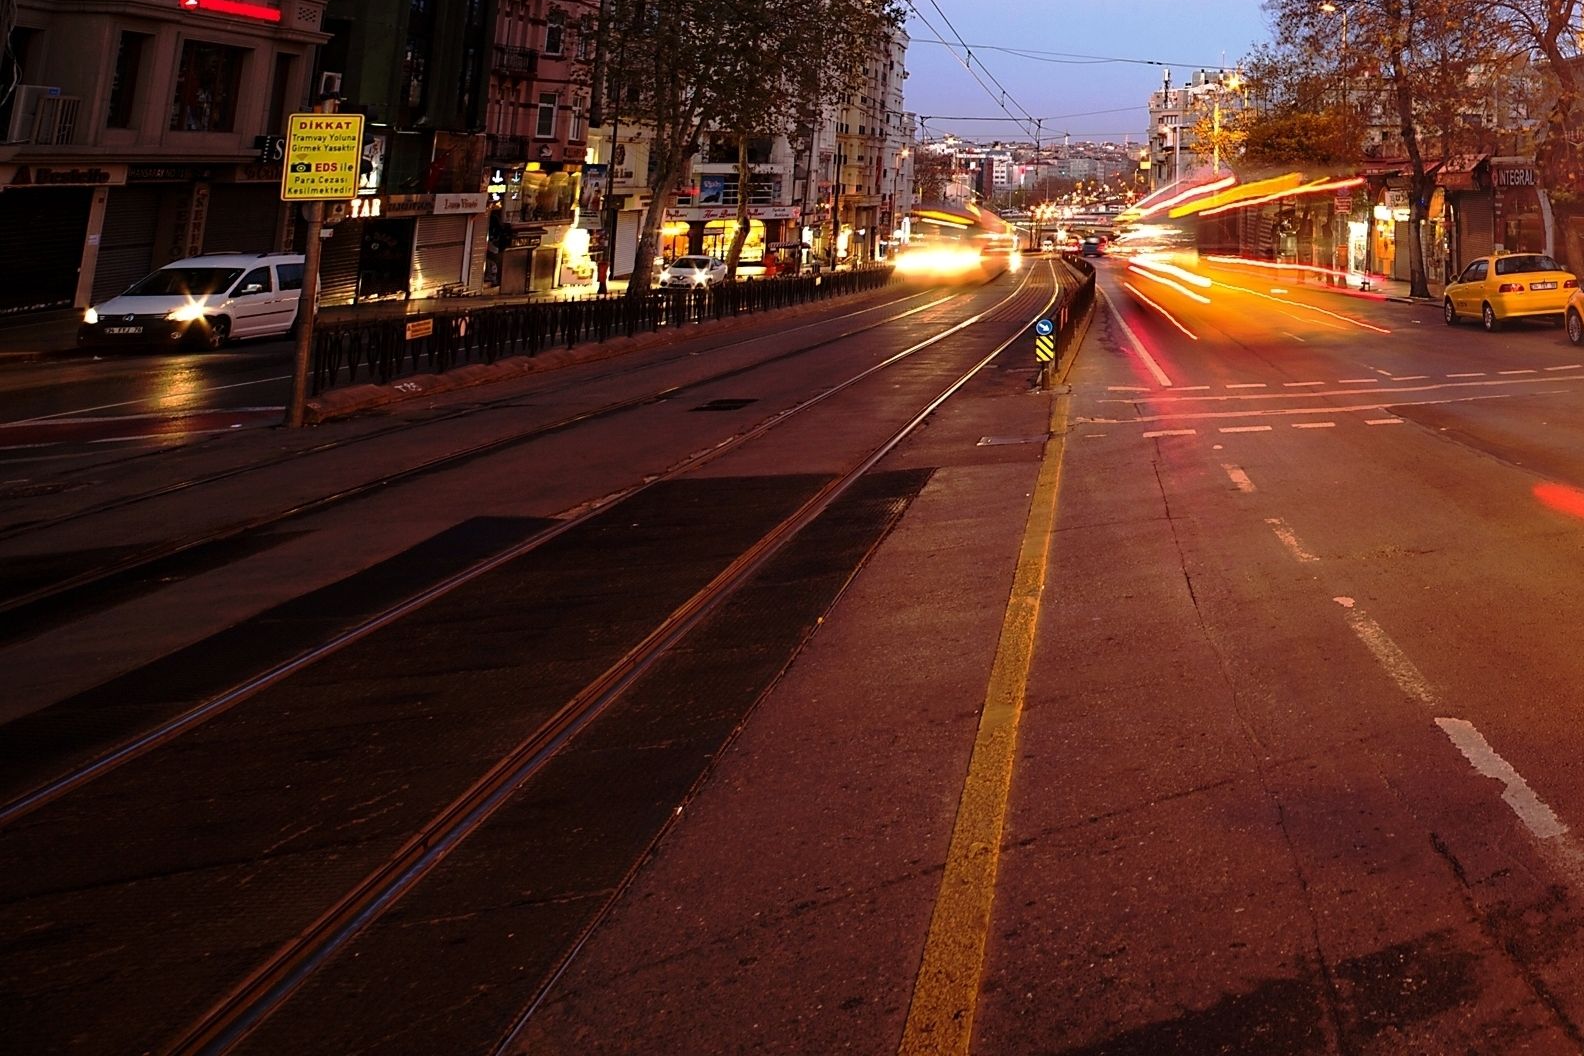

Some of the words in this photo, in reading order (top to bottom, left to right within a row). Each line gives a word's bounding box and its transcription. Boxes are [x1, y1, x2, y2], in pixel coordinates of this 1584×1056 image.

[300, 120, 352, 130] DİKKAT
[292, 134, 327, 143] Tramvay
[329, 134, 357, 142] Yoluna
[291, 144, 321, 152] Girmek
[315, 163, 338, 172] EDS
[340, 162, 354, 172] ile
[294, 176, 316, 184] Para
[1499, 169, 1535, 186] INTEGRAL
[287, 186, 352, 194] Kesilmektedir
